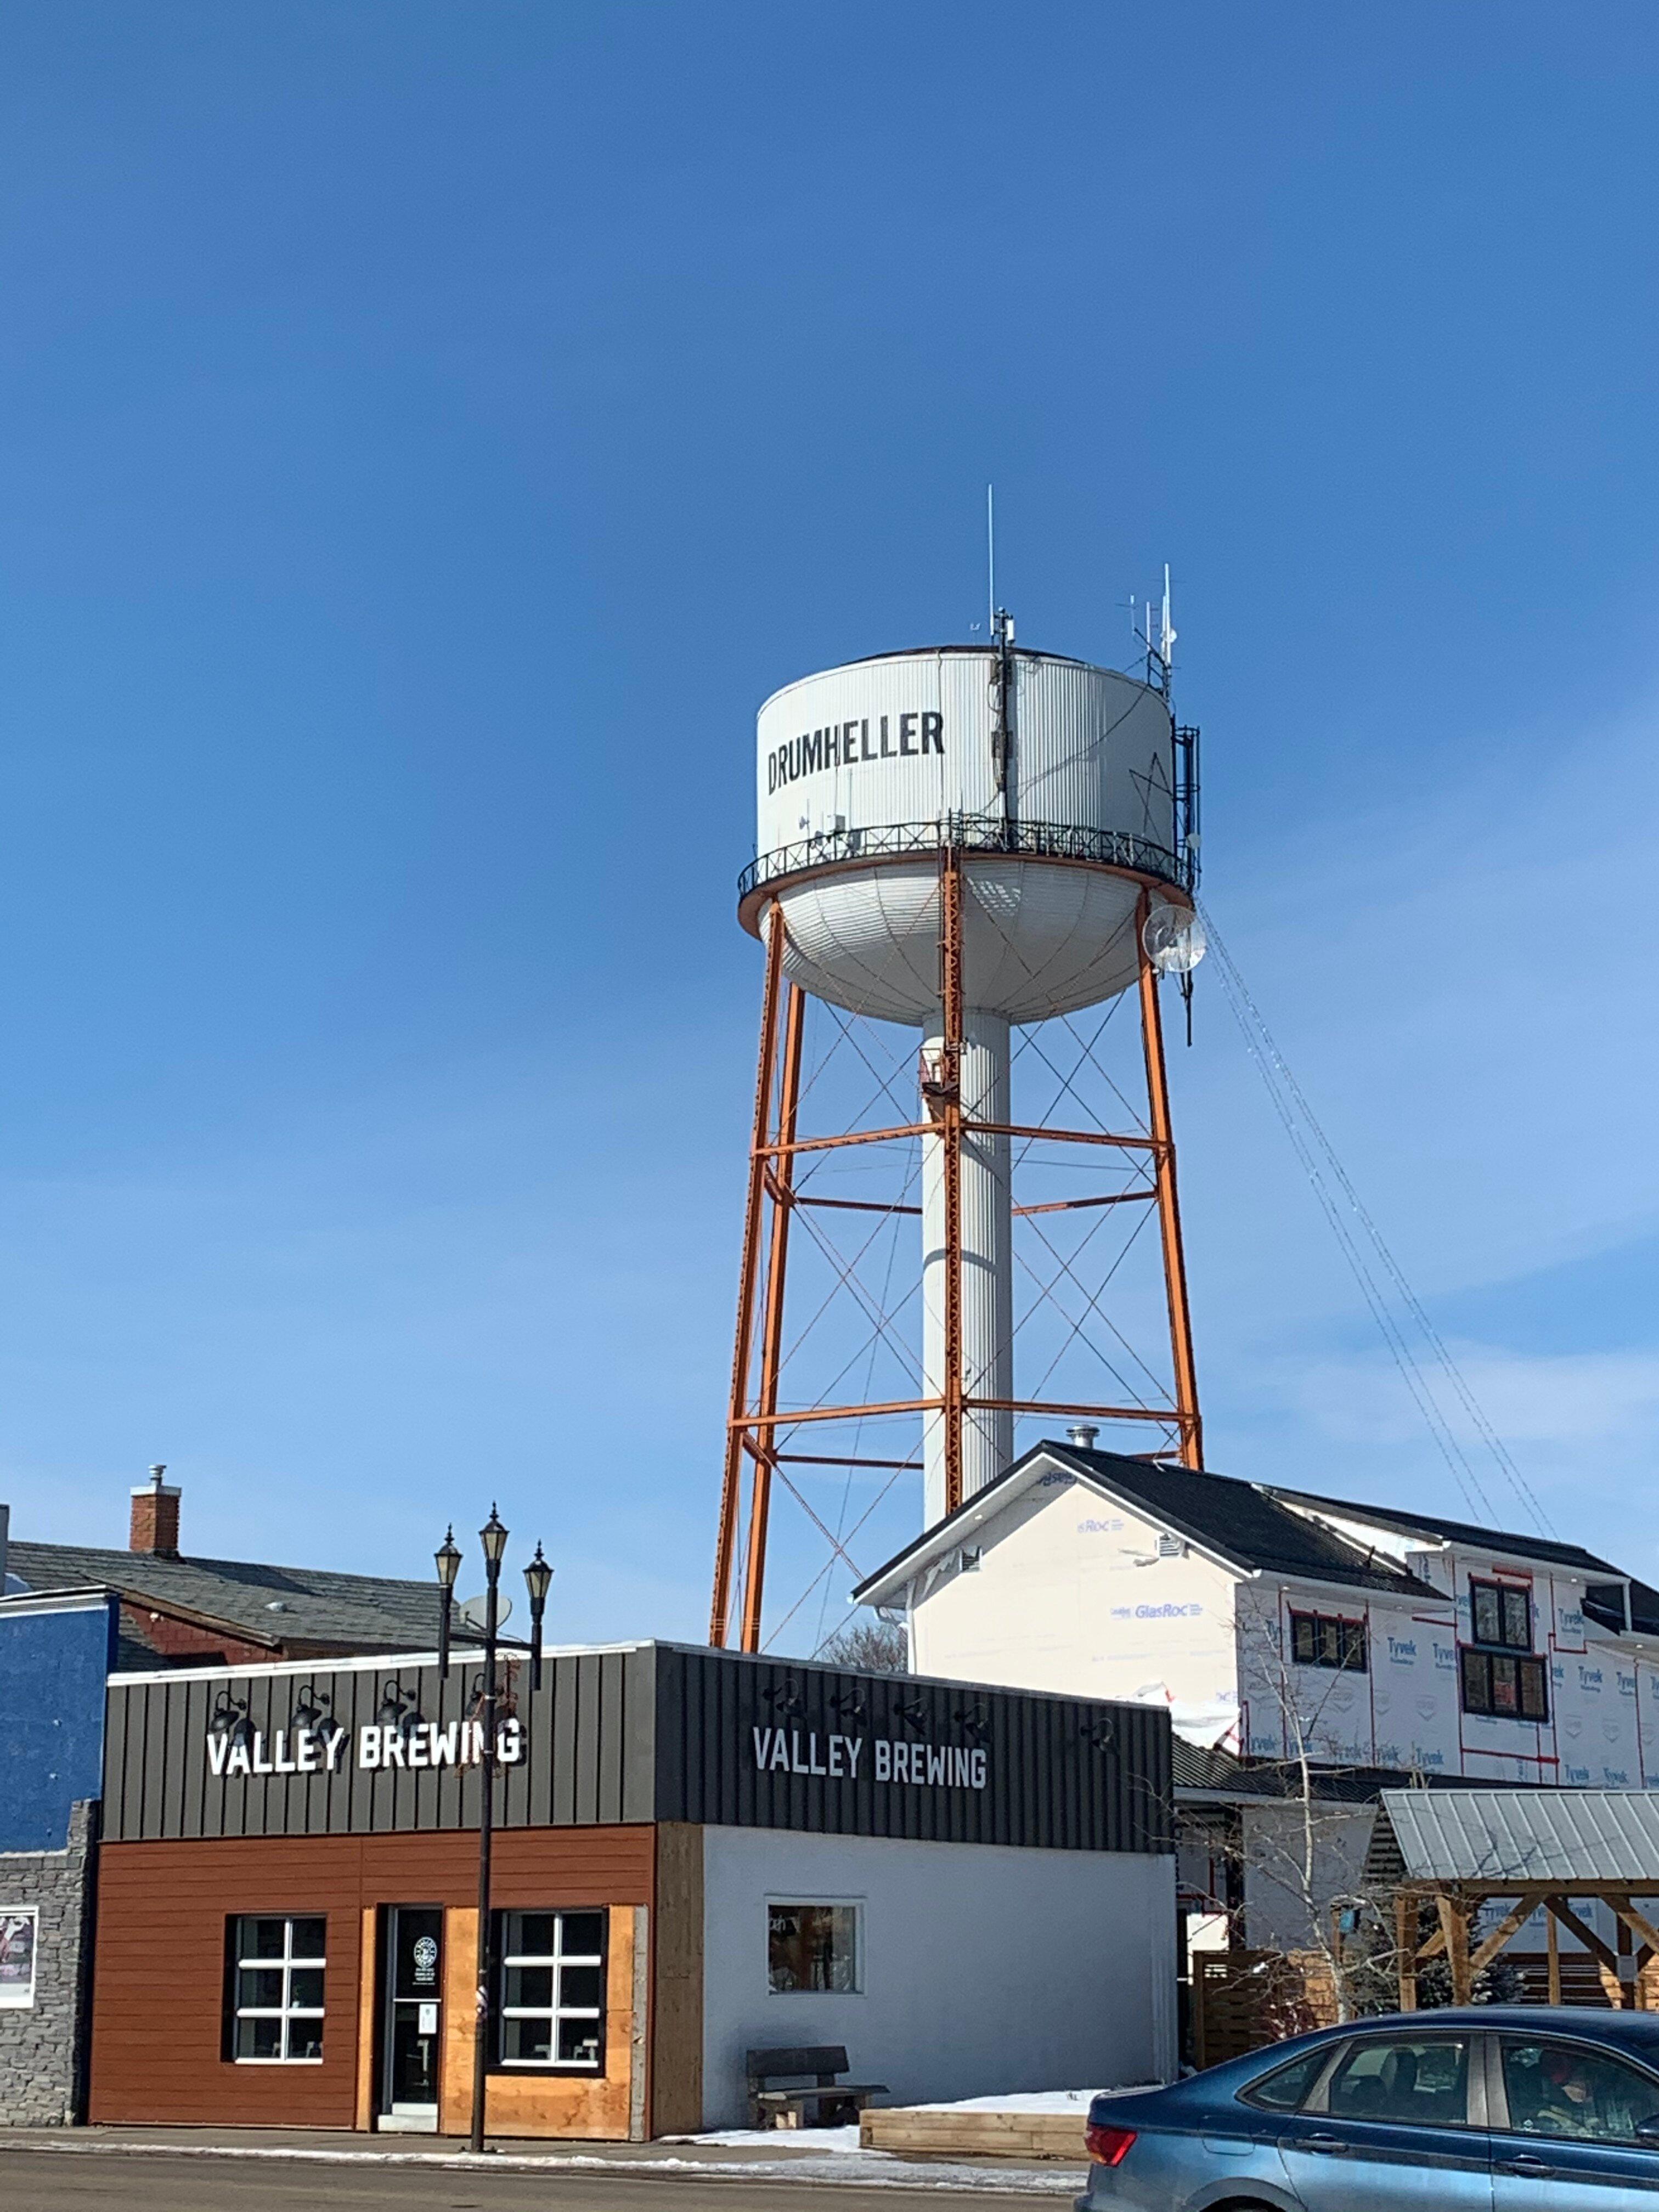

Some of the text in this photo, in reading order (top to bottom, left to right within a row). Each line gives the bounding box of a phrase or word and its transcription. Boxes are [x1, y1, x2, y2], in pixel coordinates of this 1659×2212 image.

[768, 712, 945, 795] DRUMHELLER
[1135, 1604, 1188, 1618] GlasRoc
[1387, 1637, 1417, 1657] Tyvek
[1433, 1643, 1455, 1663] Tyve
[1578, 1666, 1602, 1684] Tyvek
[207, 1728, 344, 1775] VALLEY
[753, 1726, 986, 1789] VALLEY BREWING
[1415, 1747, 1444, 1767] Tyvek
[1565, 1764, 1589, 1783] Tyvek
